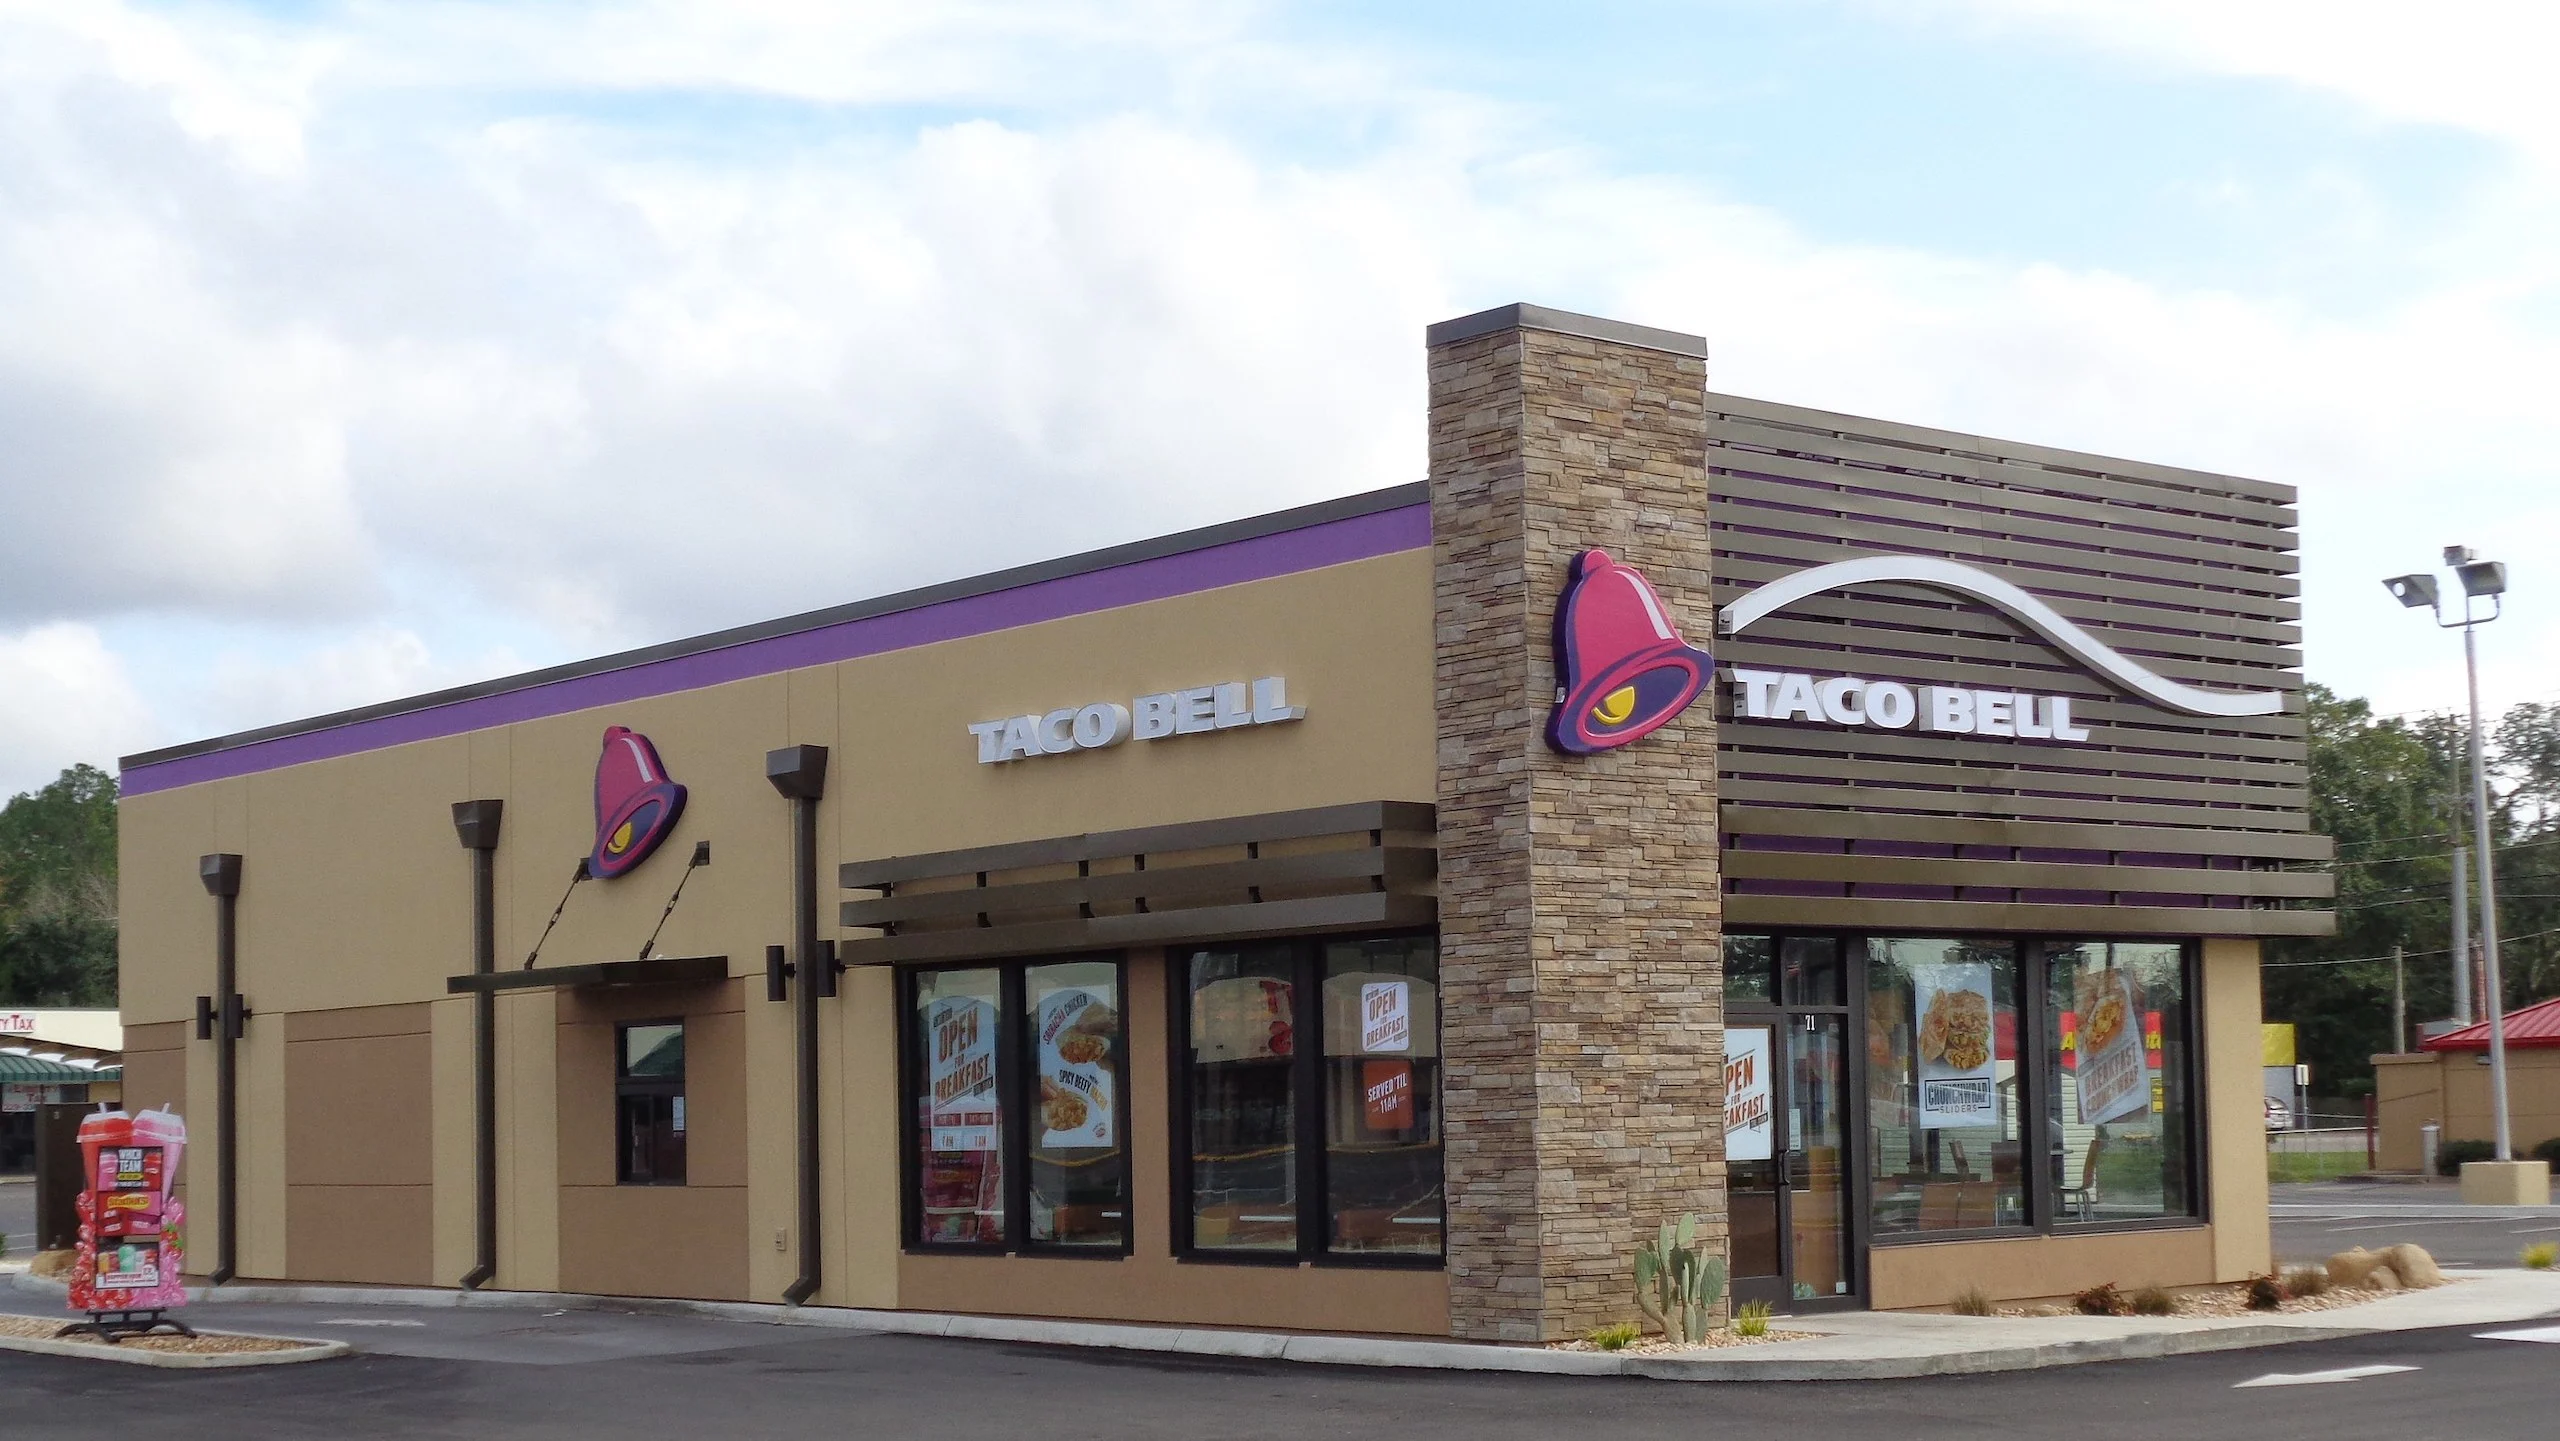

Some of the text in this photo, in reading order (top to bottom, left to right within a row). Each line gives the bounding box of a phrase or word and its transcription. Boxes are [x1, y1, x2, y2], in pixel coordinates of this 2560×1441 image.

[1721, 668, 2091, 742] TACO BELL
[968, 676, 1307, 763] TACO BELL
[1064, 993, 1088, 1017] CHICKEN
[1369, 988, 1396, 1021] OPEN
[939, 1007, 978, 1063] OPEN
[1366, 1015, 1404, 1046] BREAKFAST
[1805, 1015, 1816, 1031] 71
[935, 1053, 989, 1105] BREAKFAST
[1059, 1069, 1075, 1085] SPICY
[1074, 1072, 1091, 1094] BEEFY
[1725, 1055, 1753, 1097] PEN
[1367, 1079, 1394, 1102] SERVED
[1730, 1093, 1741, 1106] FOR
[1928, 1082, 1987, 1105] CRUNCHWRAP
[1380, 1094, 1398, 1114] 11AM
[1723, 1093, 1765, 1129] EAKFAST
[1939, 1104, 1977, 1114] SLIDERS
[119, 1160, 141, 1172] TEAM
